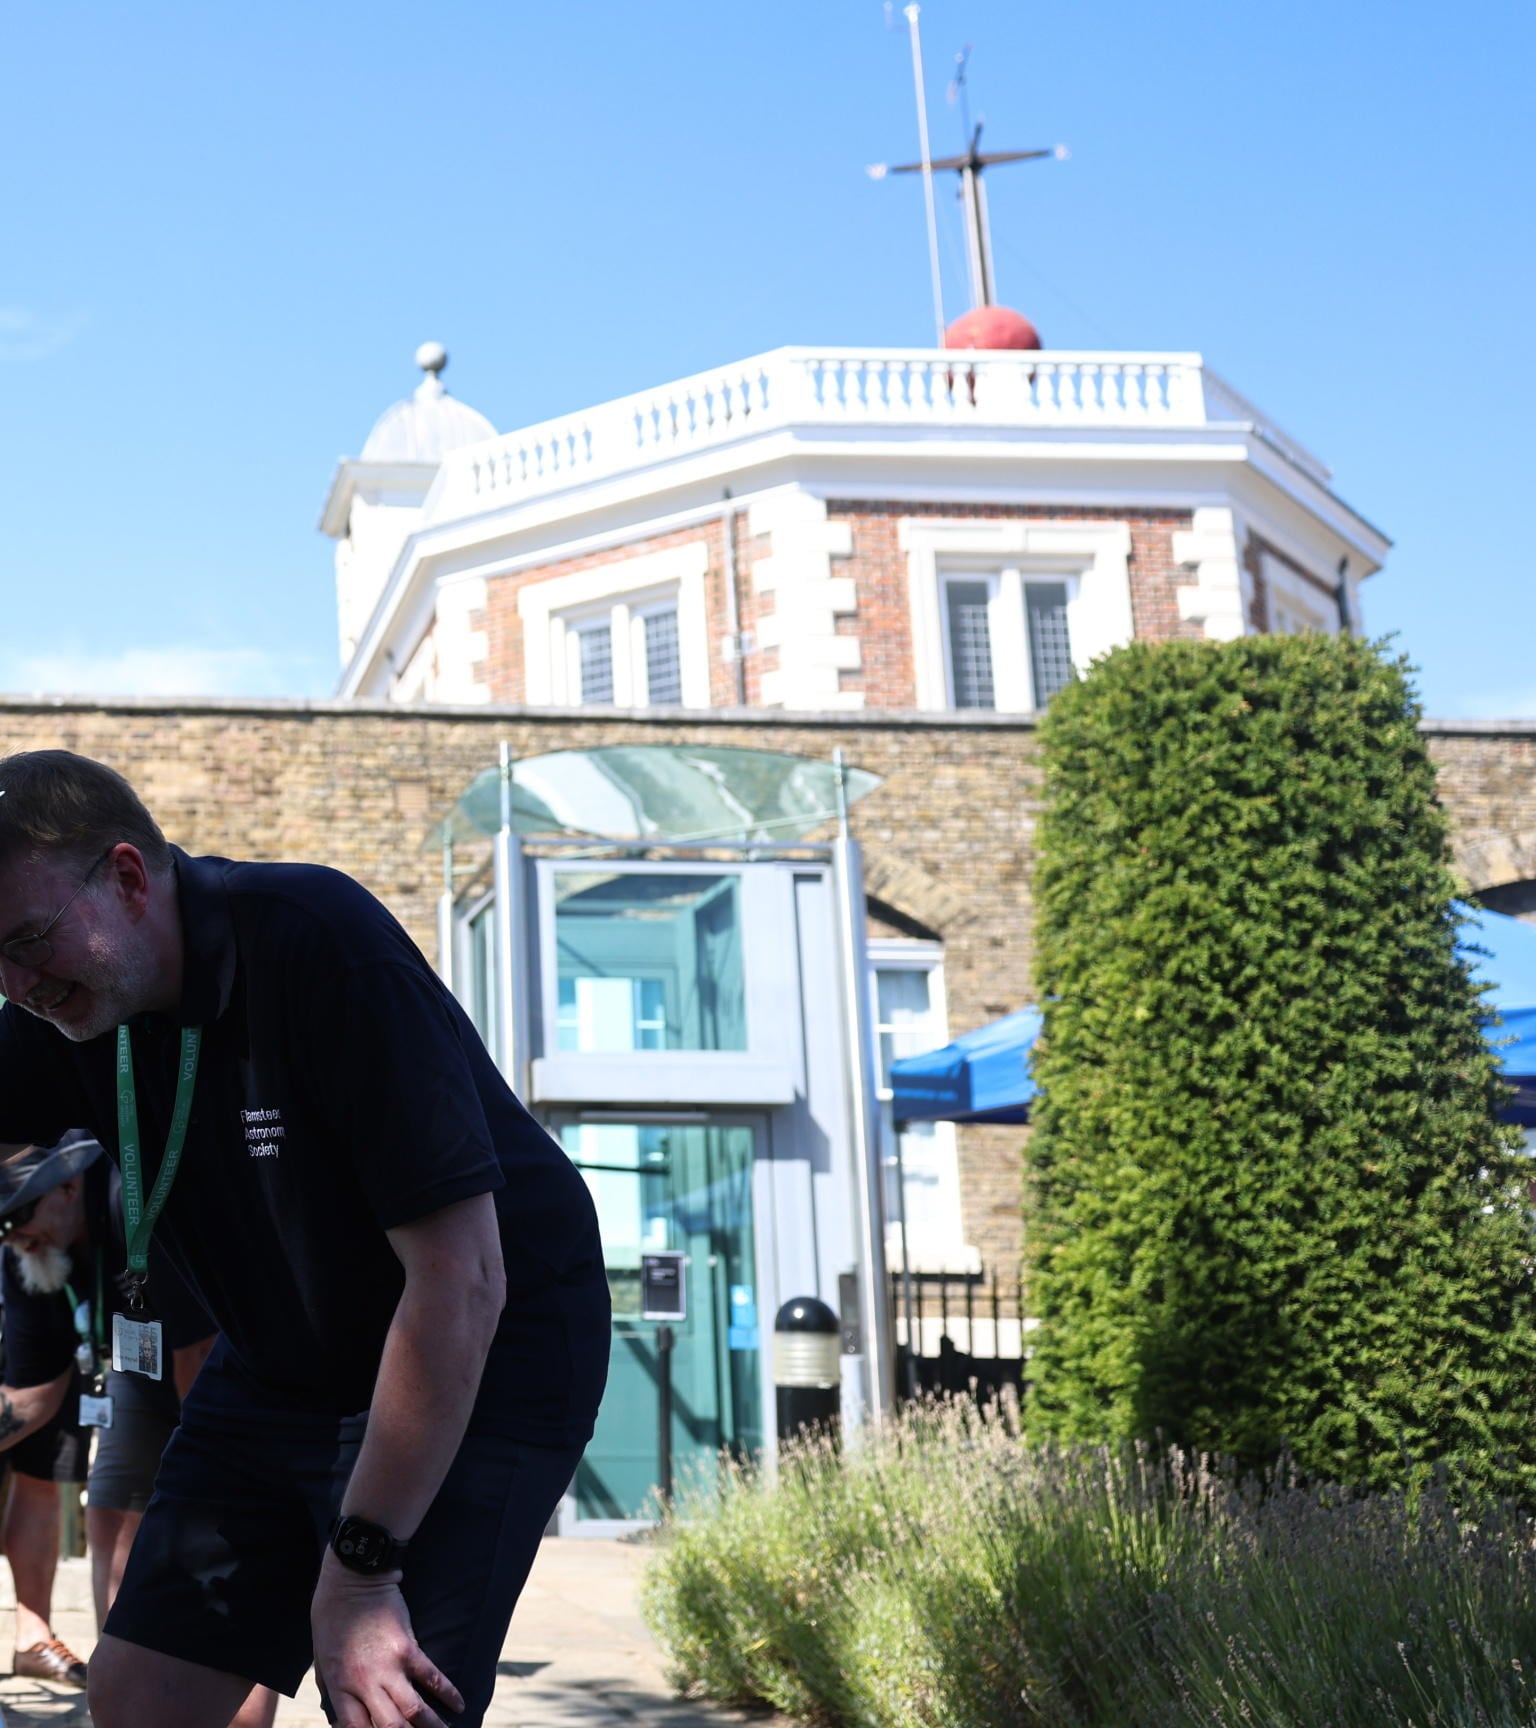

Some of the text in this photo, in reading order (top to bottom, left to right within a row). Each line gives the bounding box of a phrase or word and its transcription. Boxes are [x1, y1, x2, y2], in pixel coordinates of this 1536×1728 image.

[124, 1144, 140, 1225] VOLUNTEER
[144, 1150, 178, 1221] VOLUNTEER
[248, 1142, 279, 1158] Society
